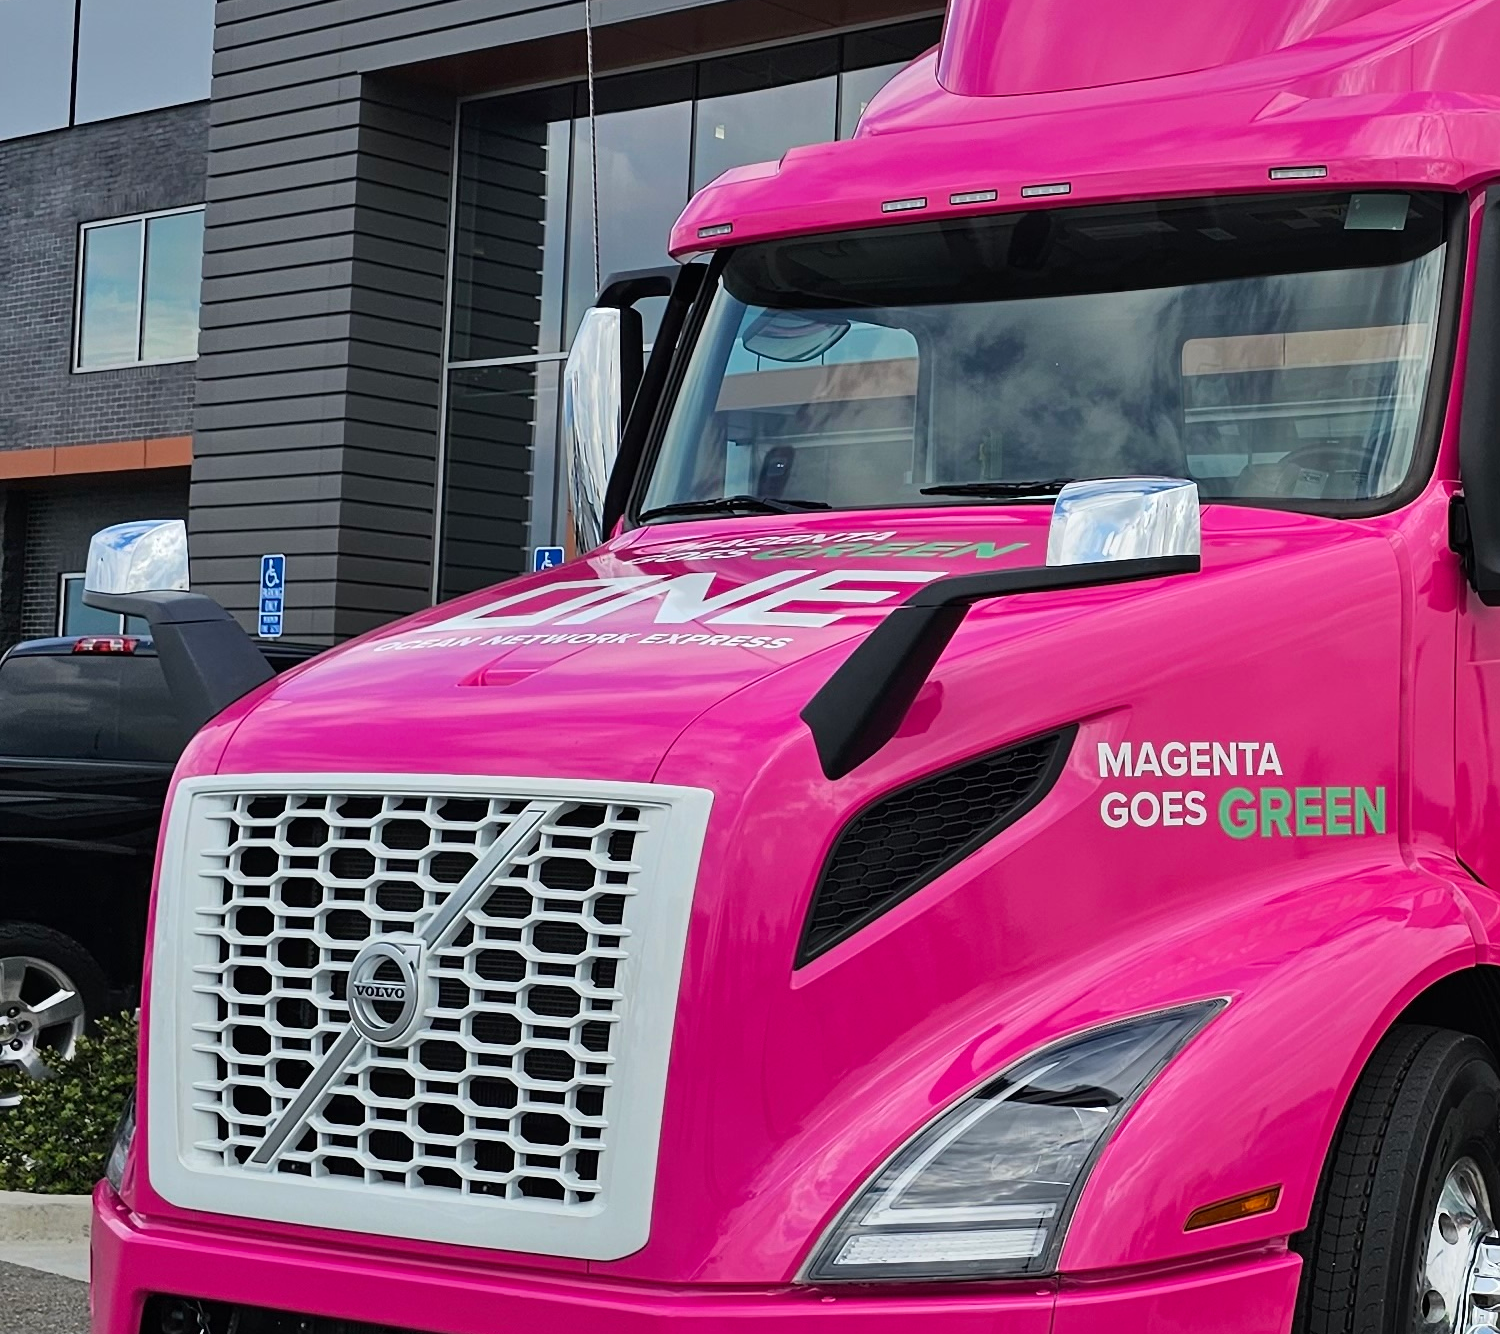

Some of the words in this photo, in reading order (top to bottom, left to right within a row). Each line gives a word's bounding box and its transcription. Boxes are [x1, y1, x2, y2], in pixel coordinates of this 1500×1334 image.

[622, 548, 760, 565] GOES
[751, 541, 1030, 561] GREEN
[664, 530, 897, 553] MAGENTA
[415, 570, 949, 633] ONE
[374, 636, 482, 652] OCEAN
[480, 634, 641, 647] NETWORK
[638, 634, 793, 649] EXPRESS
[1097, 741, 1283, 778] MAGENTA
[1101, 790, 1207, 828] GOES
[1219, 786, 1386, 840] GREEN
[355, 986, 405, 999] VOLVO
